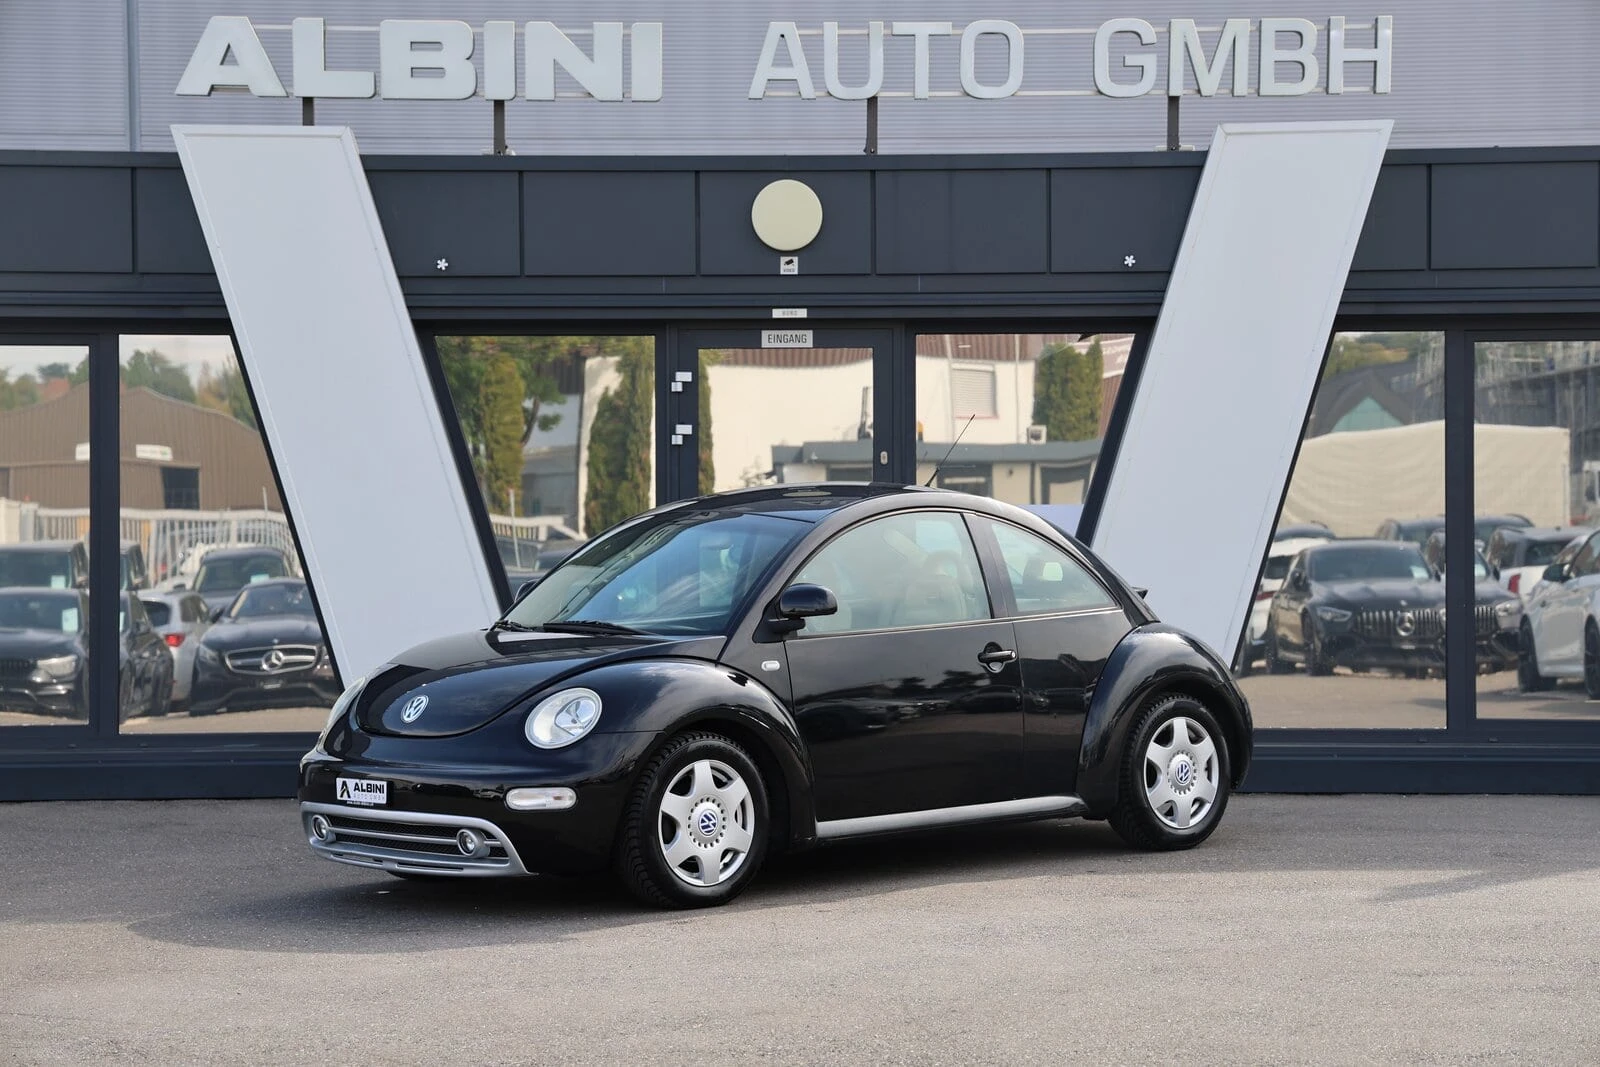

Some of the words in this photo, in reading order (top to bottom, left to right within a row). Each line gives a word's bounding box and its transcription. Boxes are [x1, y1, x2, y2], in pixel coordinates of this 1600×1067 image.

[174, 15, 663, 102] ALBINI
[748, 19, 1024, 100] AUTO
[1092, 15, 1393, 98] GMBH
[767, 333, 807, 344] EINGANG
[353, 782, 385, 794] ALBINI
